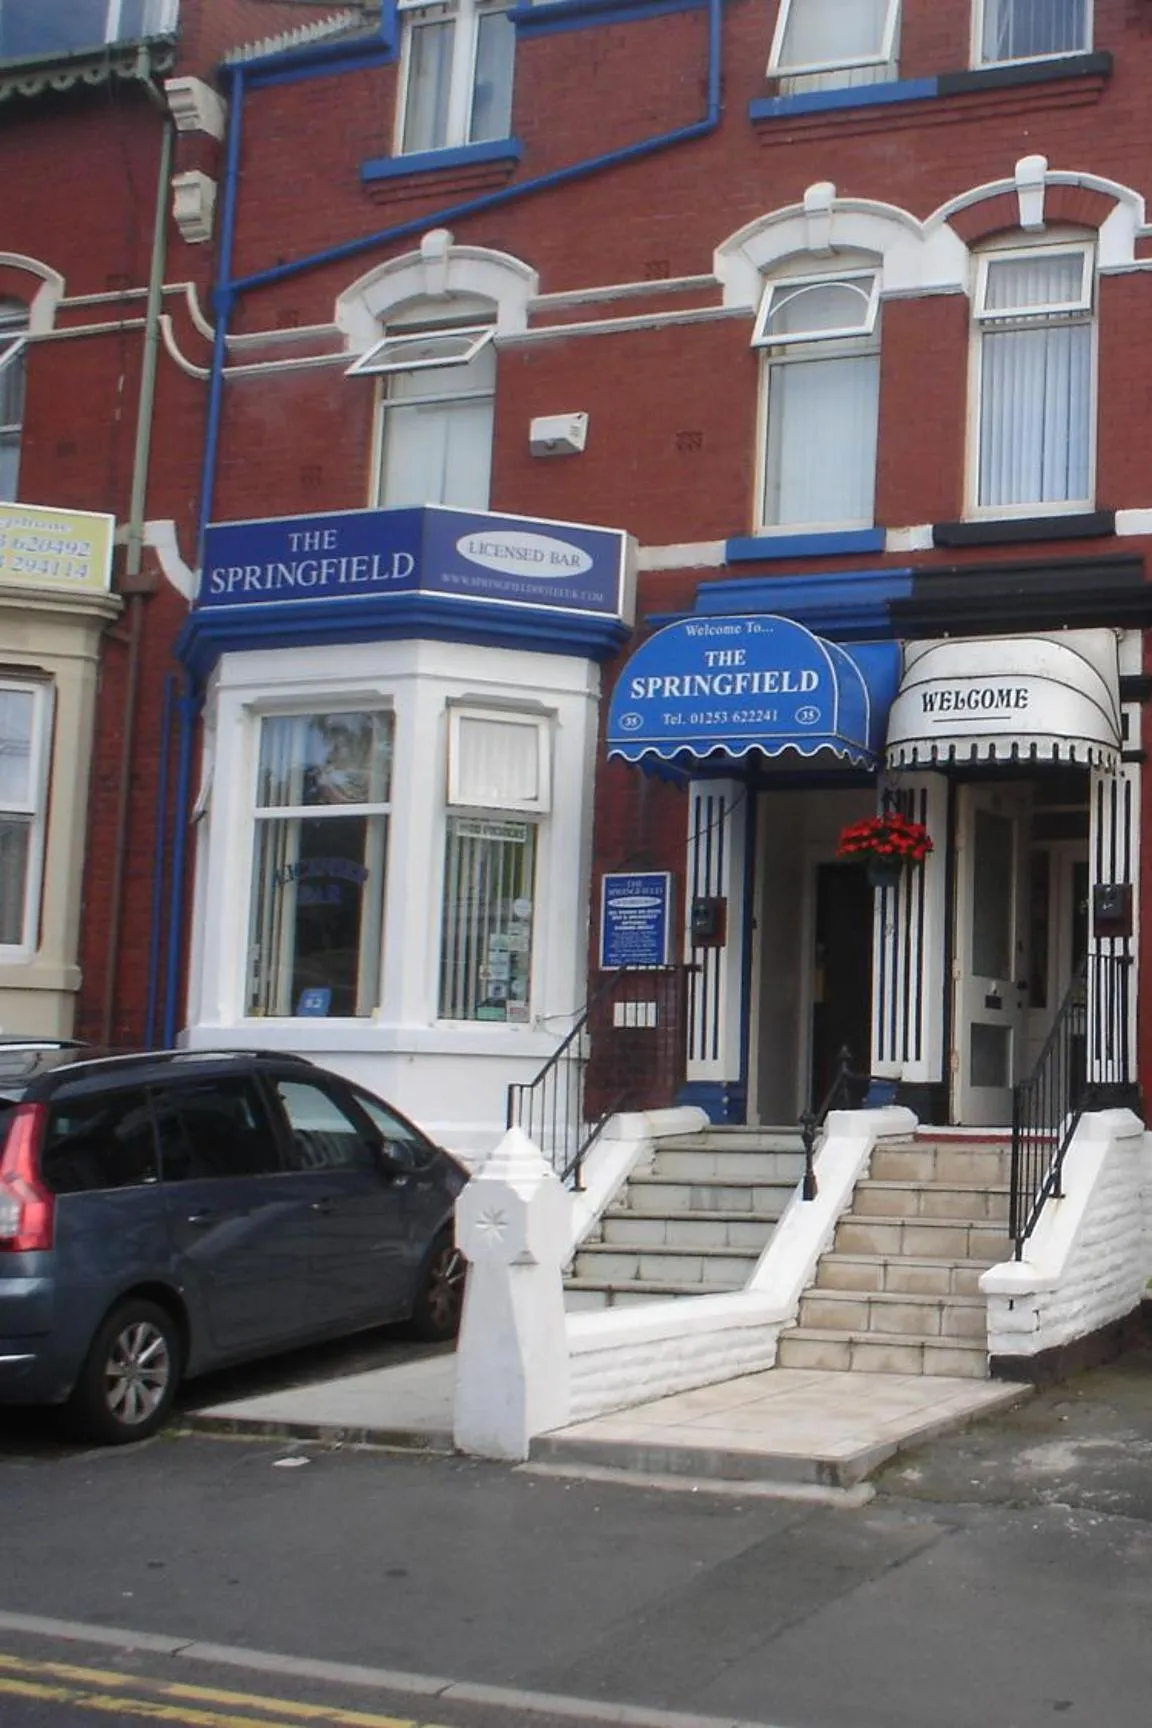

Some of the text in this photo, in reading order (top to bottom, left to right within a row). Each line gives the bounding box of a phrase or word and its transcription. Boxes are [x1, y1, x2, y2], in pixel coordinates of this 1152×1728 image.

[288, 529, 338, 552] THE
[469, 540, 582, 568] LICENSED BAR
[210, 552, 415, 594] SPRINGFIELD
[686, 623, 742, 637] Welcome
[705, 649, 746, 667] THE
[630, 670, 819, 700] SPRINGFIELD
[921, 688, 1029, 713] WELCOME
[625, 716, 638, 727] 35
[663, 709, 779, 726] Tel. 01253 622241
[801, 709, 815, 721] 35
